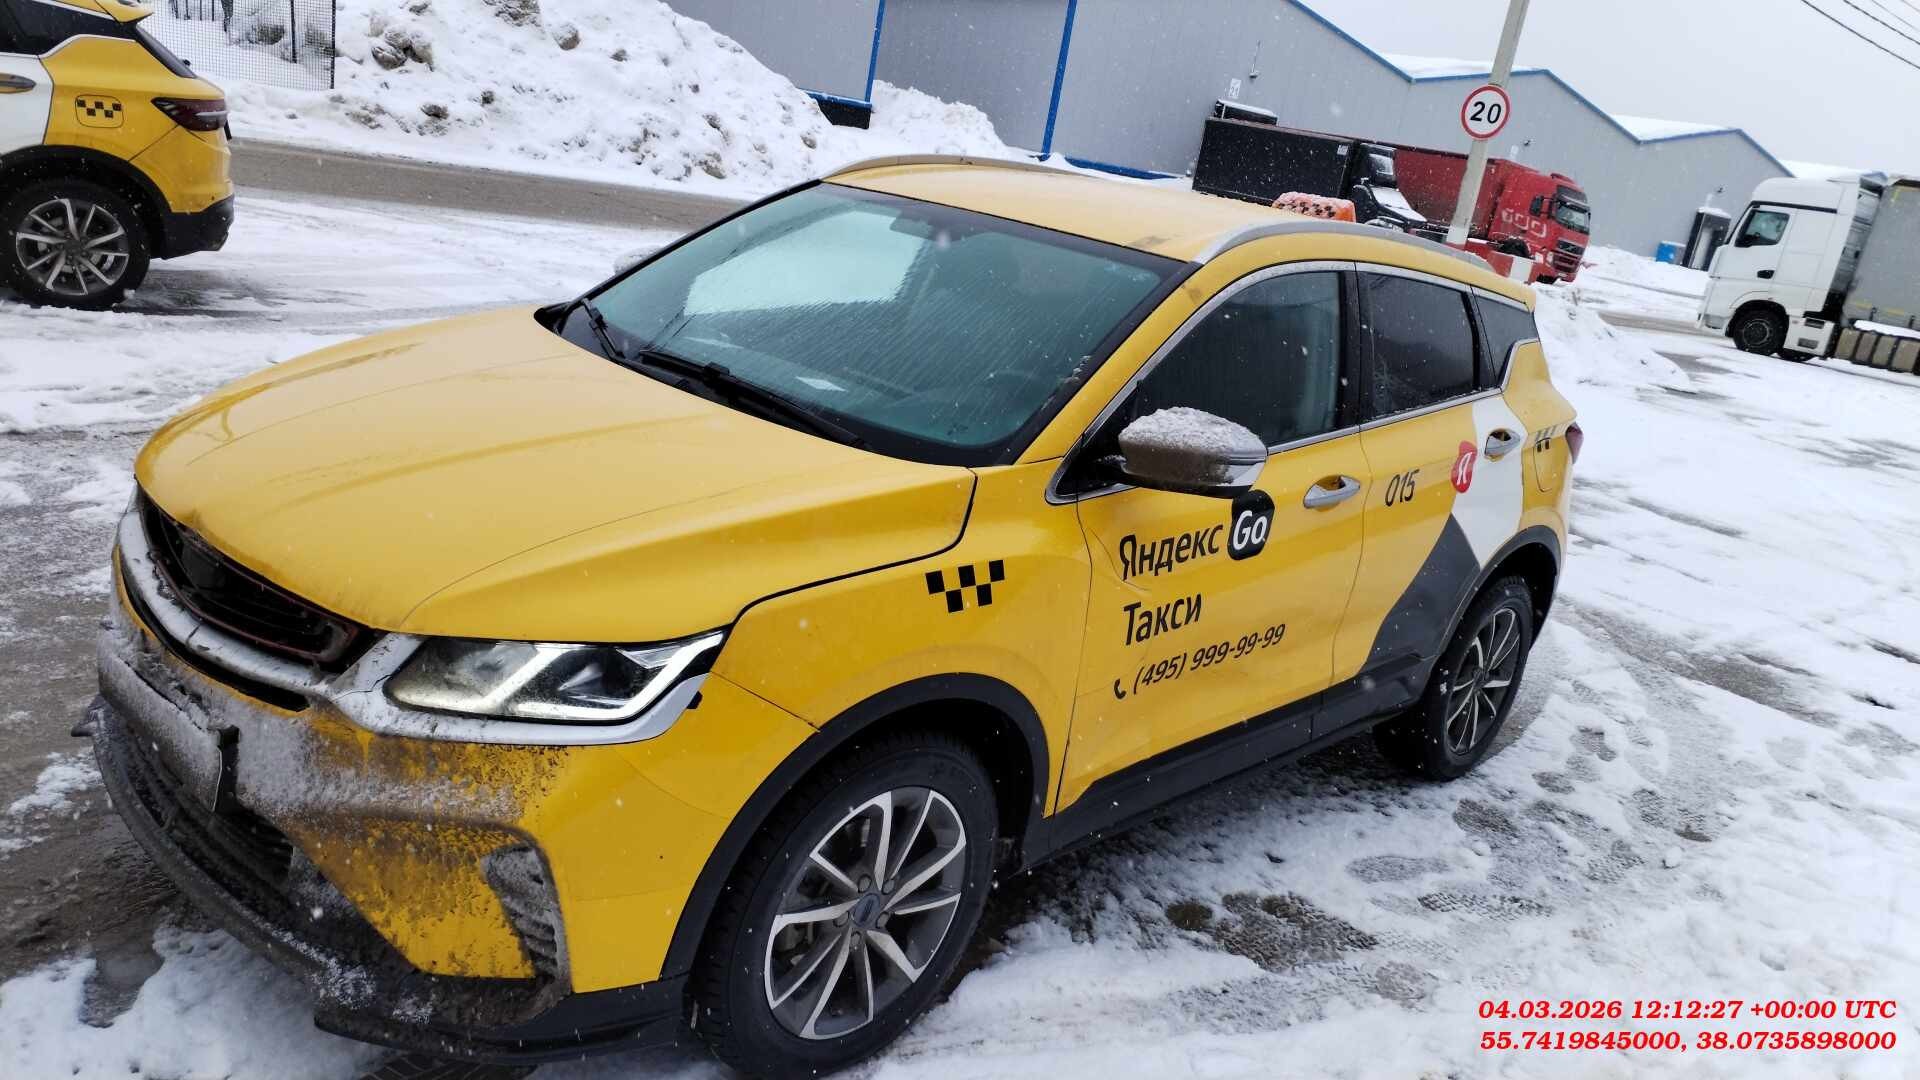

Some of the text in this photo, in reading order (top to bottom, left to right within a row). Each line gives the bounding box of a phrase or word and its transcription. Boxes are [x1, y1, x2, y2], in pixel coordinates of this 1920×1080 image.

[1470, 101, 1502, 124] 20
[1385, 468, 1420, 507] 015
[1456, 451, 1473, 486] Я
[1119, 510, 1268, 581] Яндекс Go
[1123, 594, 1202, 646] Такси
[1133, 623, 1286, 695] (495) 999-99-99
